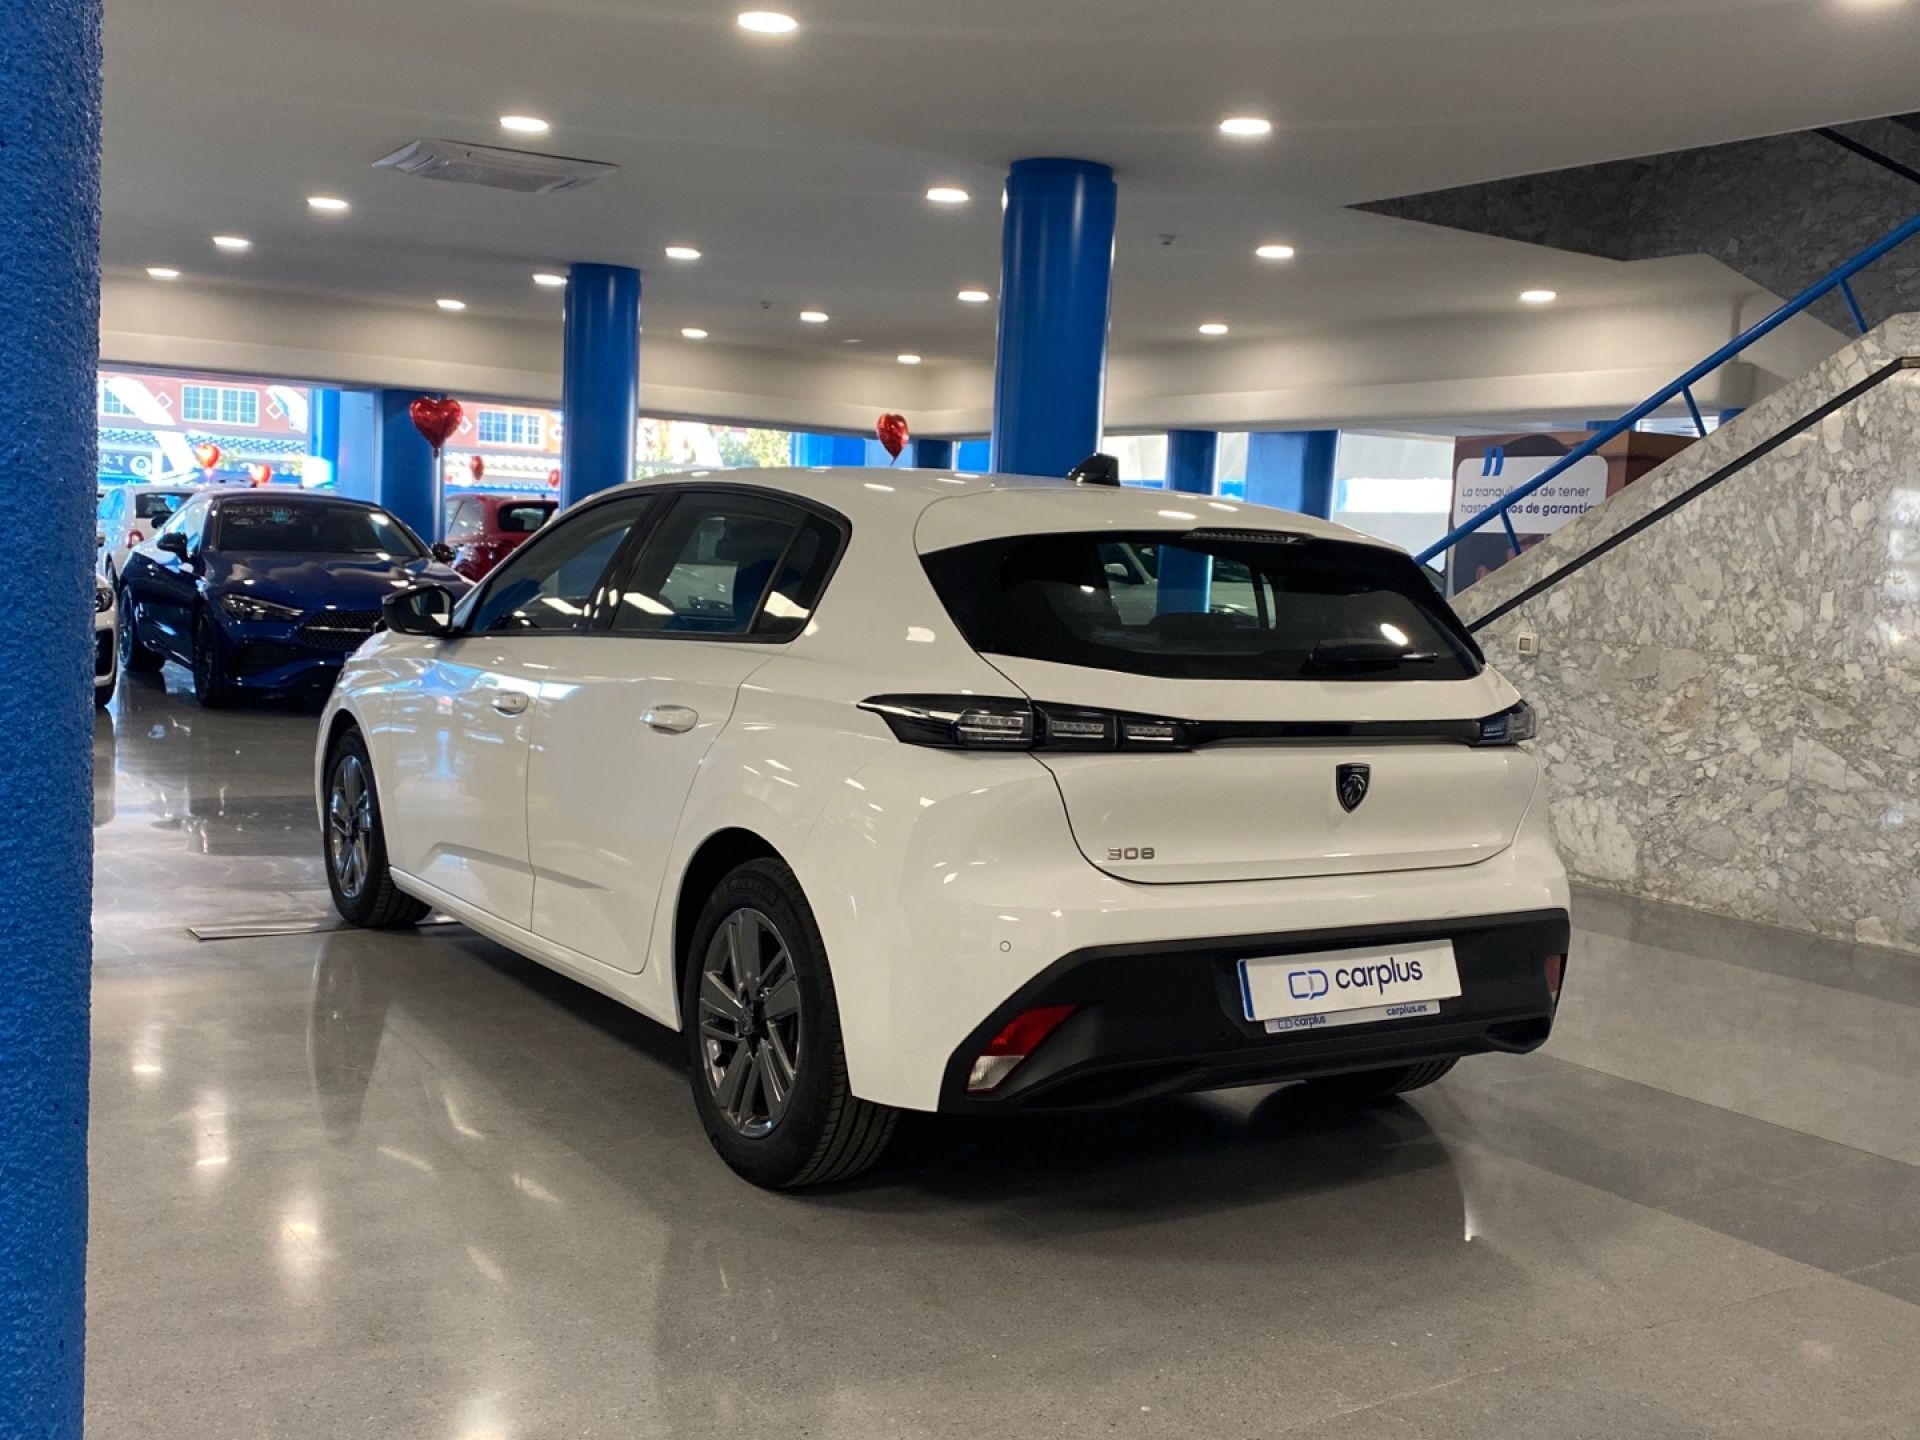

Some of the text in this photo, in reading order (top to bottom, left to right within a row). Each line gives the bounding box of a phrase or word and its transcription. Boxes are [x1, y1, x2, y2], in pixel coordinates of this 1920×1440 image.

[1462, 485, 1590, 499] La tranqui de tener
[1526, 503, 1540, 514] de
[1108, 847, 1155, 860] 308
[1335, 957, 1424, 995] carplus
[1294, 1003, 1428, 1028] carplus carplus.es
